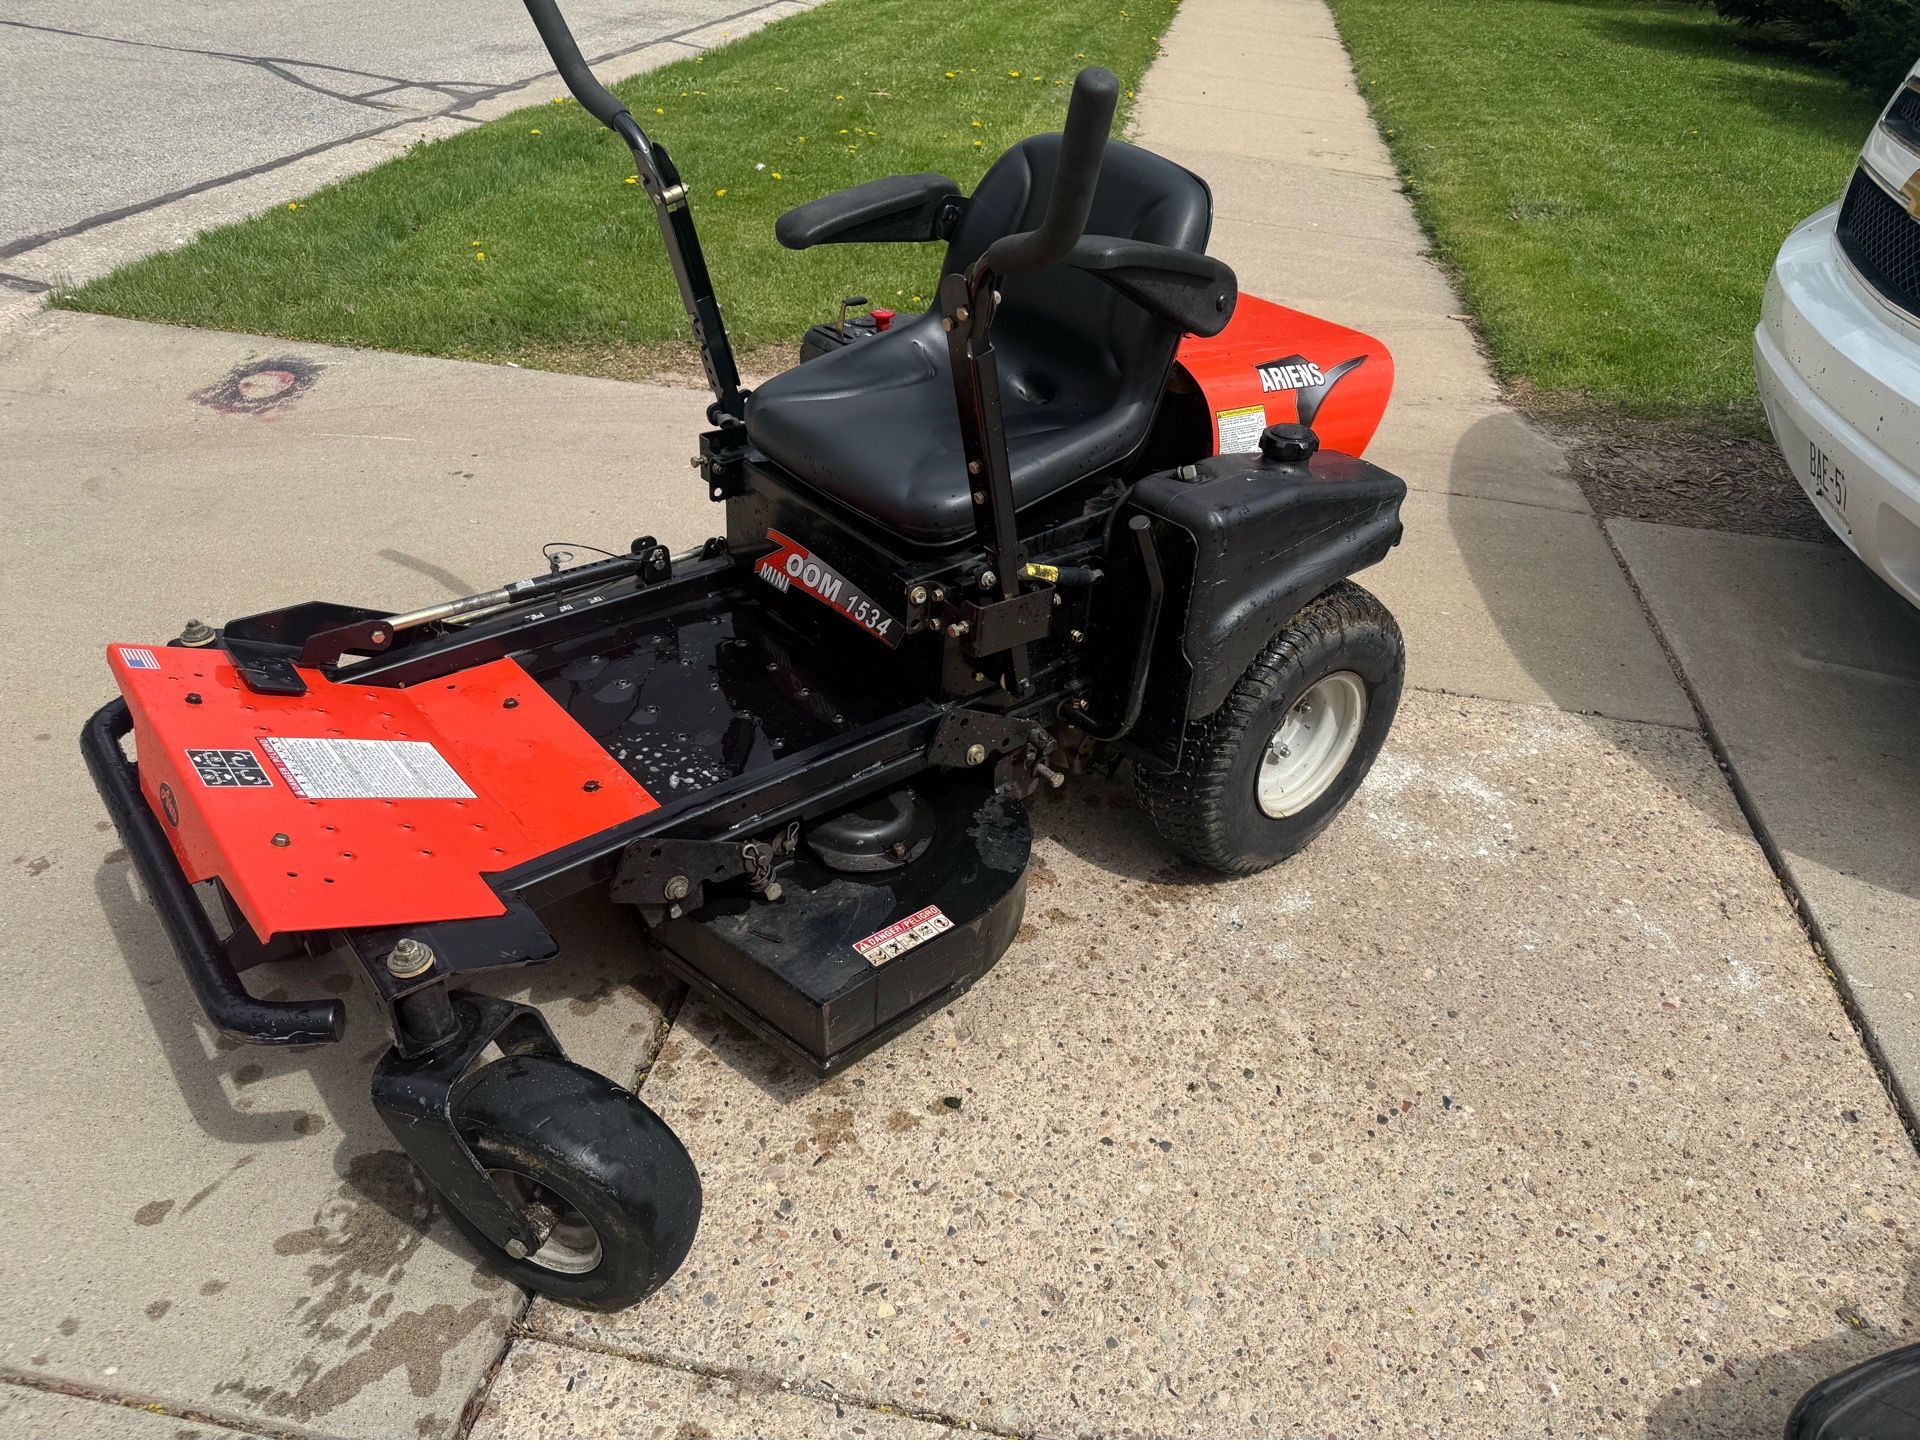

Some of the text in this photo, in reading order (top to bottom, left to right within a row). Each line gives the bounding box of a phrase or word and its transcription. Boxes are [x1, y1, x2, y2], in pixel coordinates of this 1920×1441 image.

[1258, 362, 1325, 393] ARIENS
[760, 562, 790, 591] MINI
[845, 595, 892, 636] 1534
